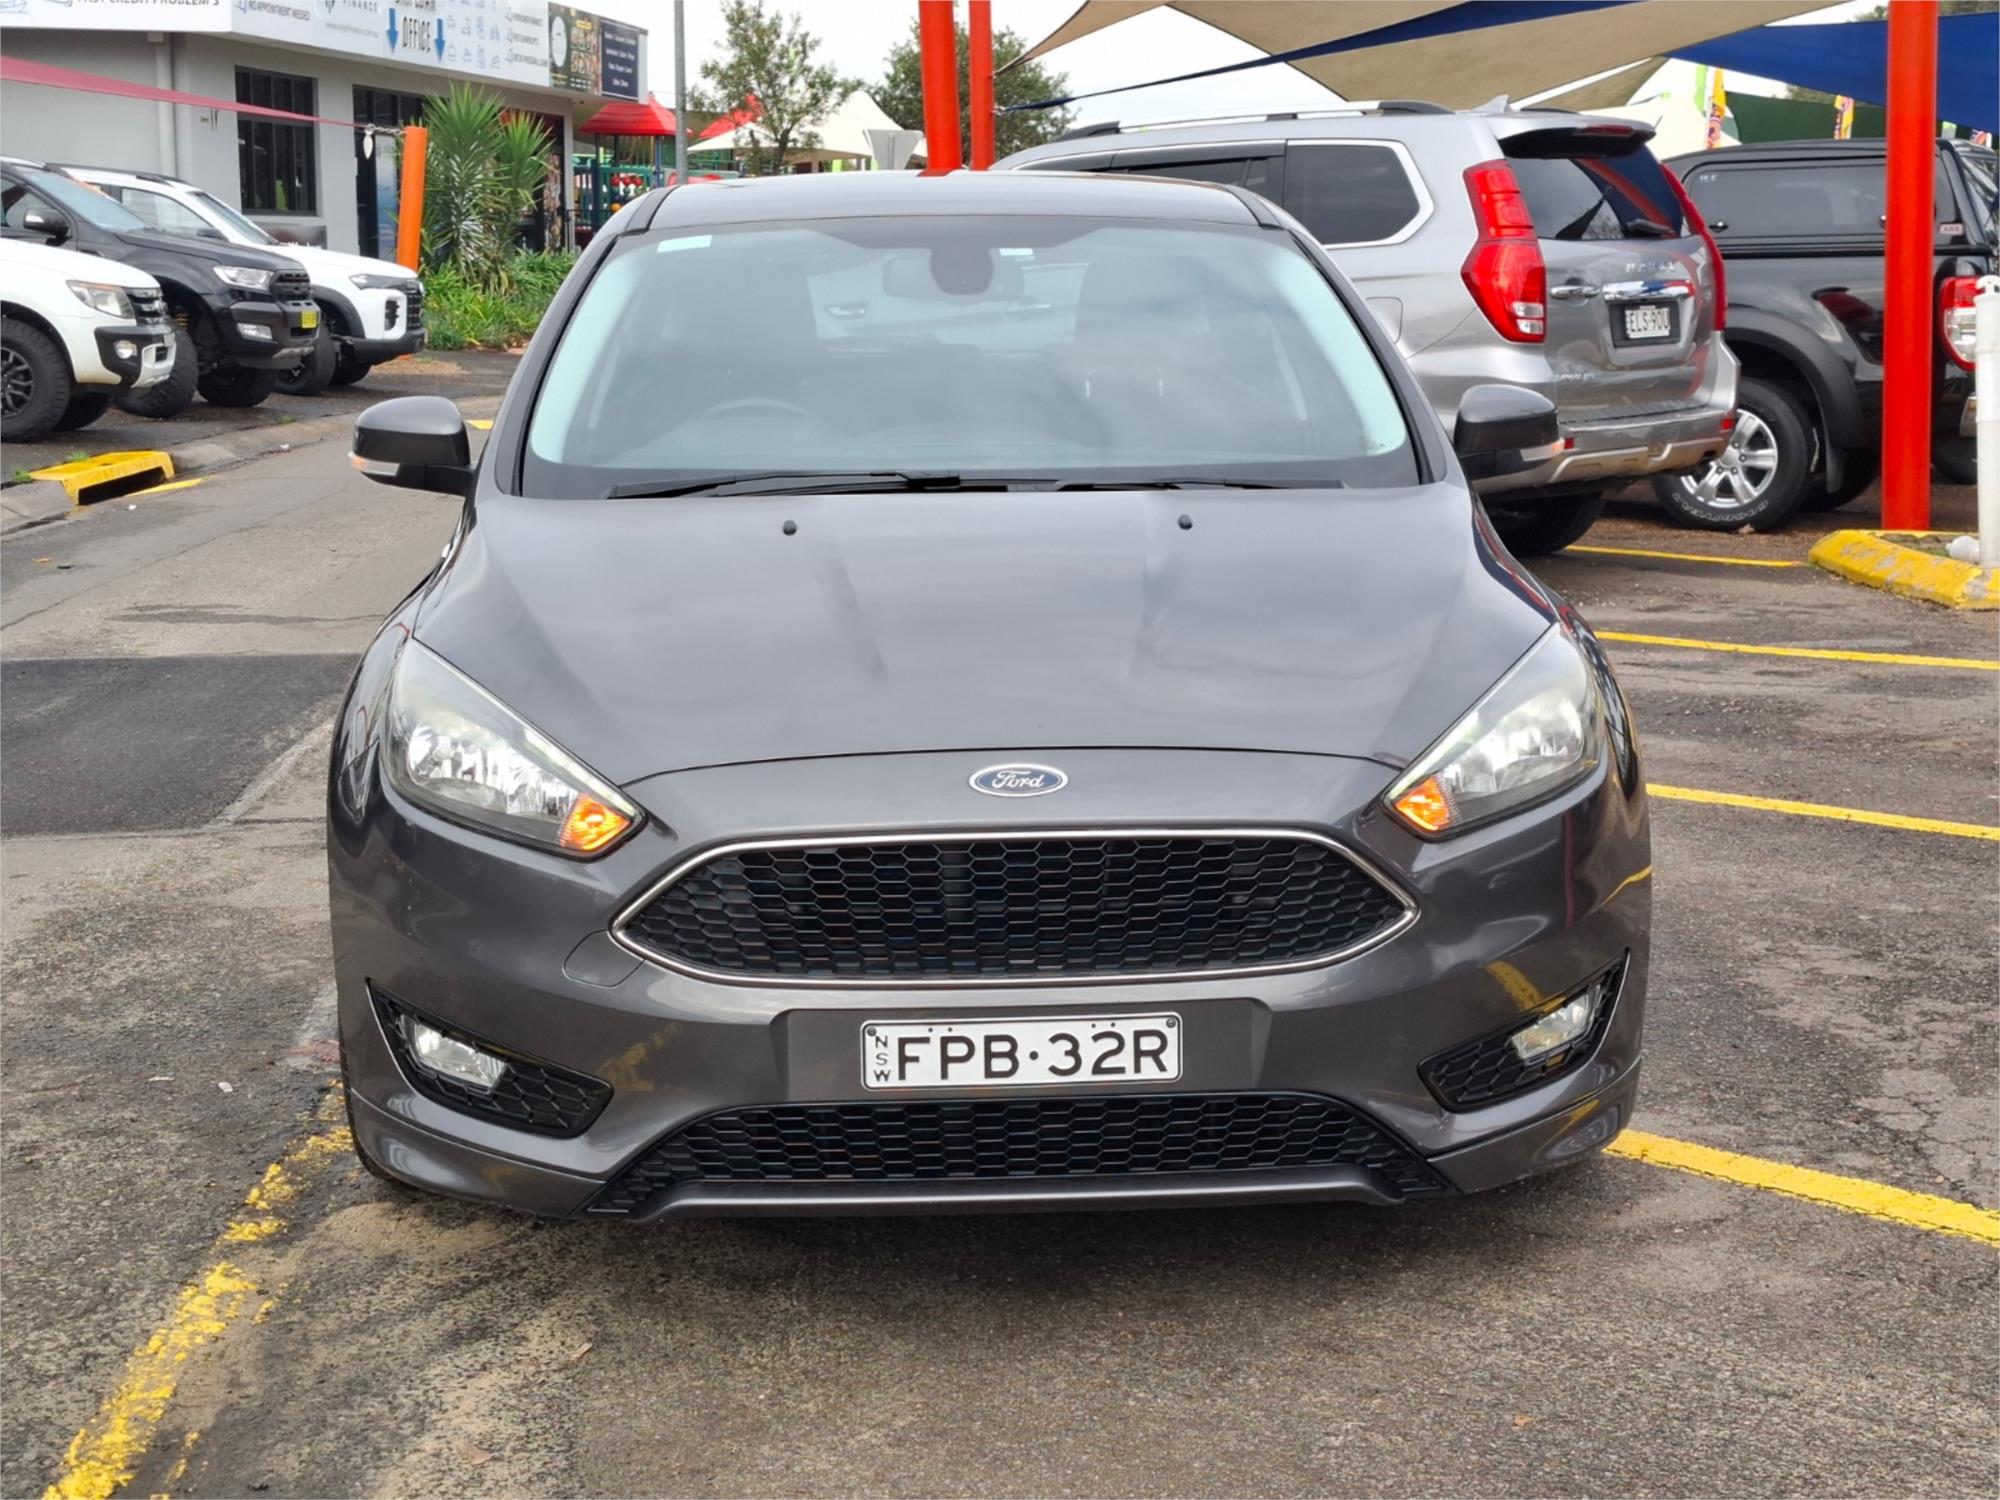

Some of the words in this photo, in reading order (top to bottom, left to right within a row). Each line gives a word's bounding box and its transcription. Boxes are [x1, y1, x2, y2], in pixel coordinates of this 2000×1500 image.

[402, 16, 431, 52] OFFICE
[991, 770, 1045, 789] Ford
[874, 1034, 891, 1082] NSW
